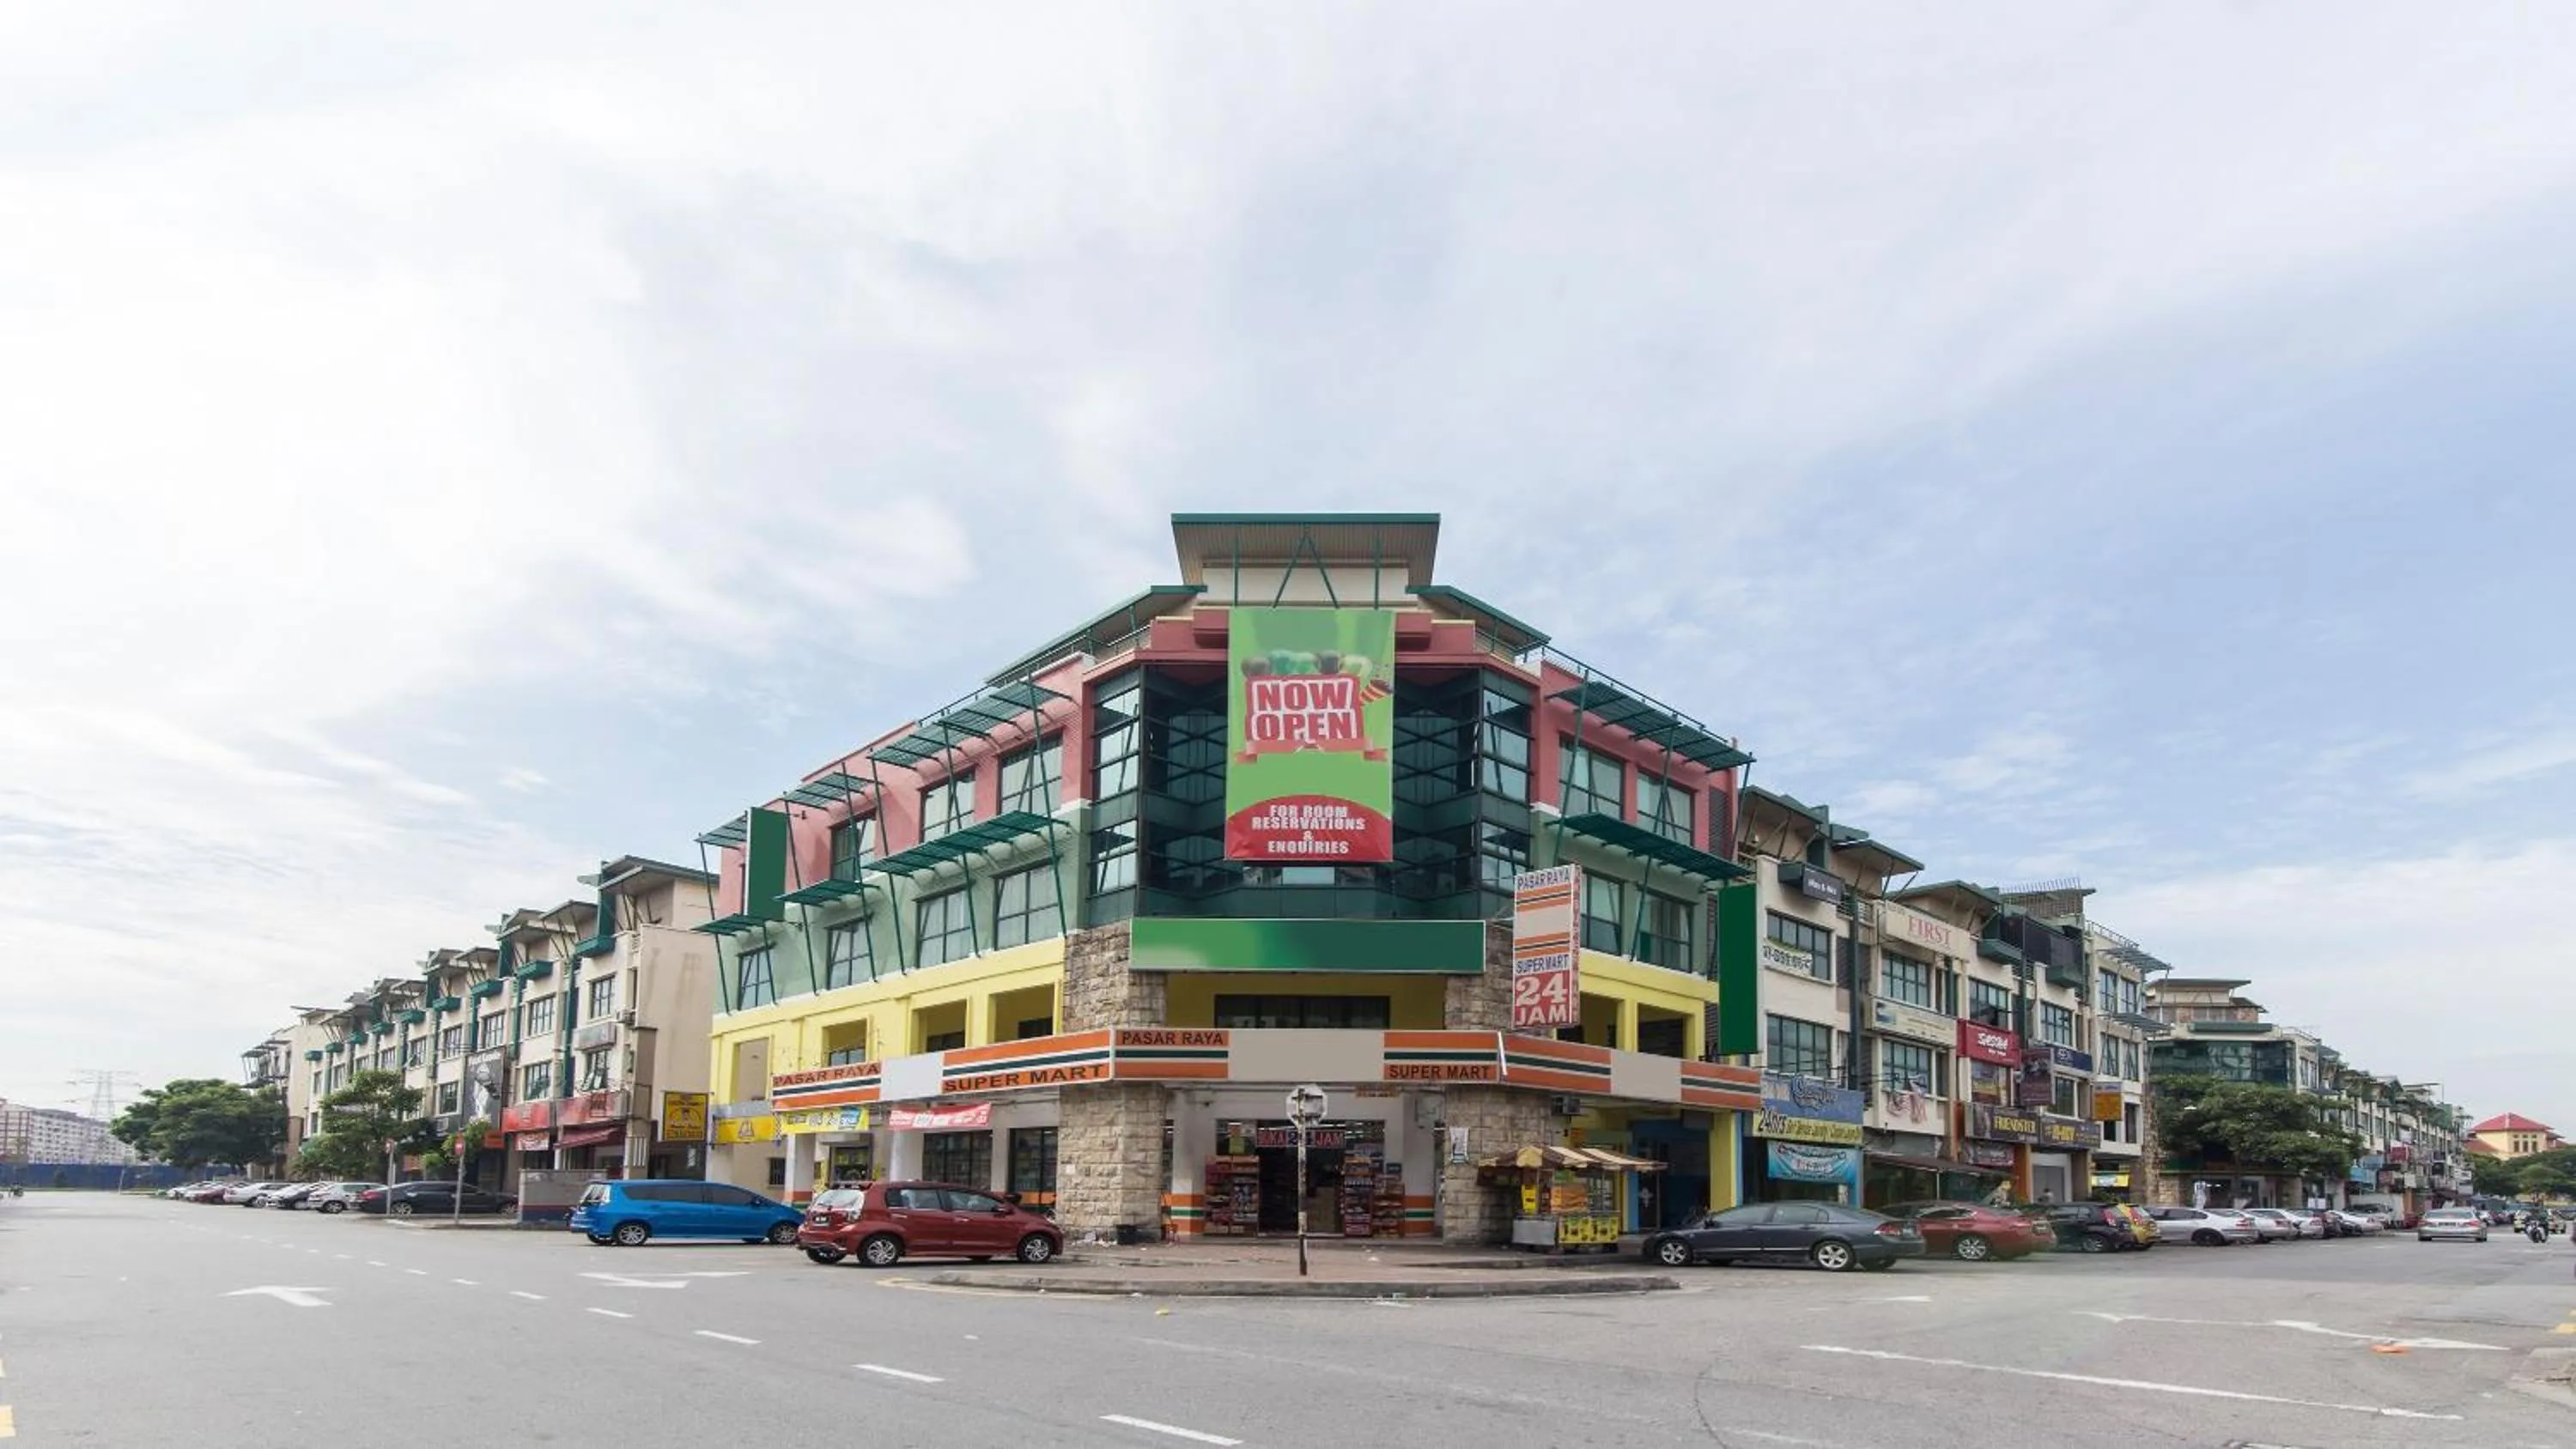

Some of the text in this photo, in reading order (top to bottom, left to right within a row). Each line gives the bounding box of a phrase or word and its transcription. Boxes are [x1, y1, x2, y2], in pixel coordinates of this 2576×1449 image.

[1254, 680, 1351, 712] NOW
[1252, 712, 1356, 742] OPEN
[1270, 804, 1347, 817] FOR ROOM
[1251, 816, 1365, 830] RESERVATIONS
[1303, 830, 1314, 840] &
[1267, 840, 1349, 853] ENQUIRIES
[1517, 870, 1570, 890] PASAR RAYA
[1908, 915, 1952, 949] FIRST
[1516, 973, 1568, 1005] 24
[1516, 1004, 1567, 1026] JAM
[1122, 1032, 1223, 1045] PASAR RAYA
[773, 1064, 878, 1087] PASAR RAYA
[944, 1064, 1104, 1093] SUPER MART
[1389, 1065, 1489, 1079] SUPER MART
[1316, 1131, 1344, 1146] JAM
